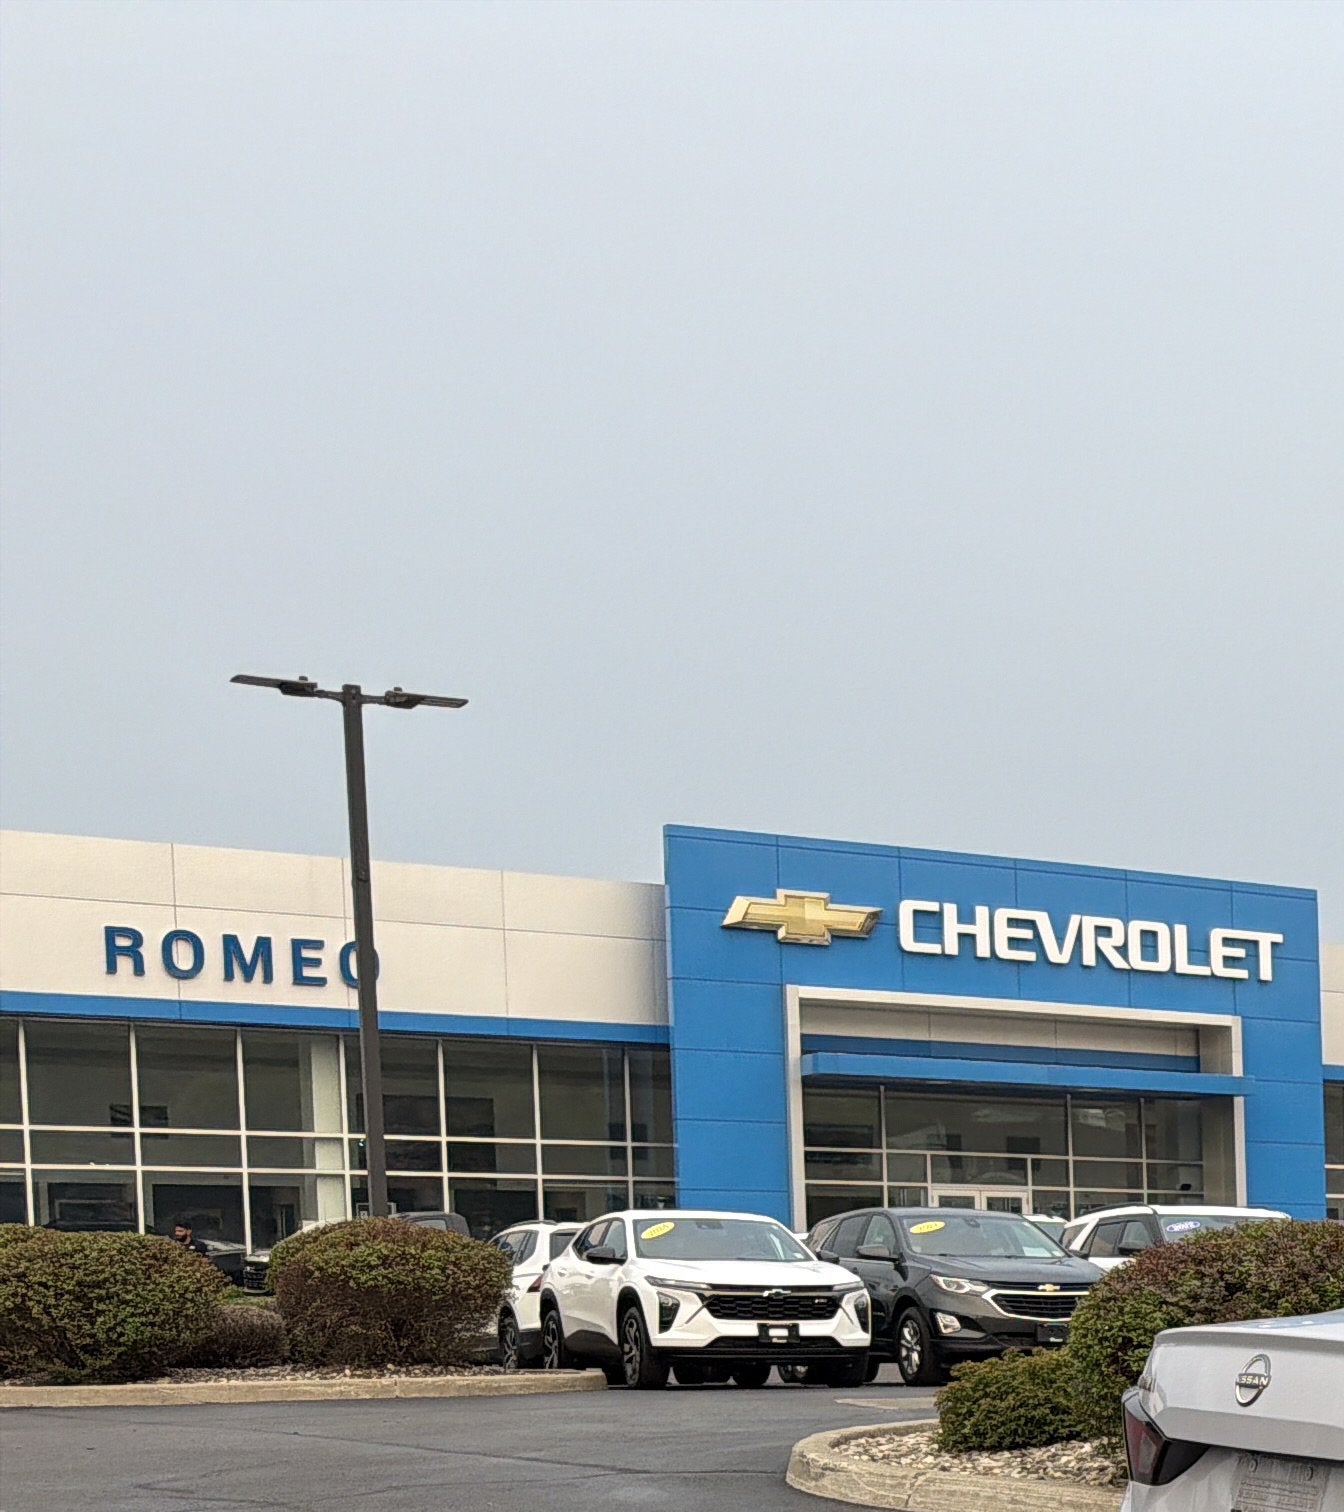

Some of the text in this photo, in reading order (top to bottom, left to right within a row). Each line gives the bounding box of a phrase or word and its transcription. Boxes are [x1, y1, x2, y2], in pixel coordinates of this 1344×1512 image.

[103, 925, 380, 990] ROMEO
[898, 899, 1284, 982] CHEVROLET
[1239, 1375, 1269, 1387] SSAN
